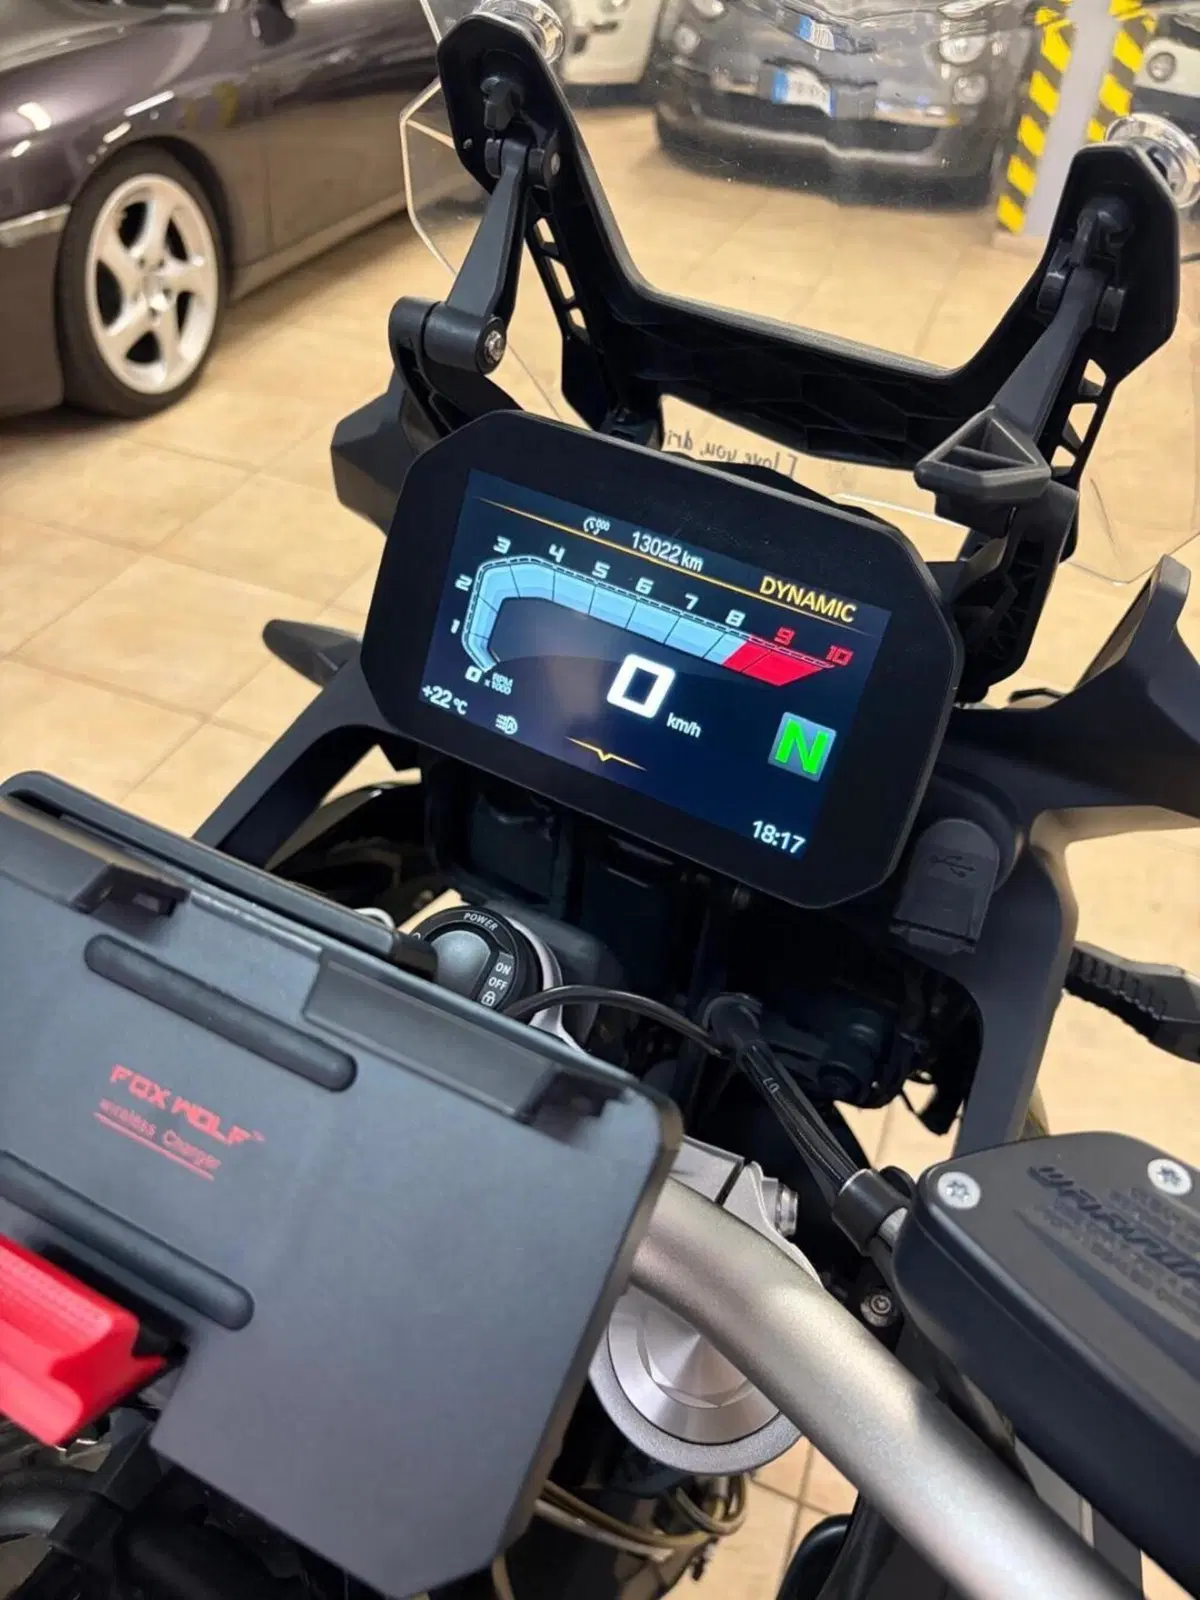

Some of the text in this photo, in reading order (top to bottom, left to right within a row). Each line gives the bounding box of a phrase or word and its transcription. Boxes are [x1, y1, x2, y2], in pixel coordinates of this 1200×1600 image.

[493, 535, 512, 554] 3
[548, 544, 566, 563] 4
[631, 530, 704, 572] 13022 km
[591, 560, 611, 579] 5
[454, 574, 473, 592] 2
[635, 577, 654, 595] 6
[684, 593, 700, 611] 7
[759, 575, 858, 623] DYNAMIC
[450, 618, 461, 634] 1
[725, 609, 746, 627] 8
[774, 626, 796, 646] 9
[826, 645, 854, 667] 10
[464, 665, 483, 683] 0
[606, 653, 676, 719] 0
[421, 684, 453, 709] +22
[666, 712, 702, 738] km/h
[774, 717, 830, 775] N
[752, 819, 806, 854] 18:17
[463, 912, 499, 931] POWER
[495, 962, 512, 976] ON
[488, 976, 509, 991] OFF
[110, 1063, 172, 1111] FOX
